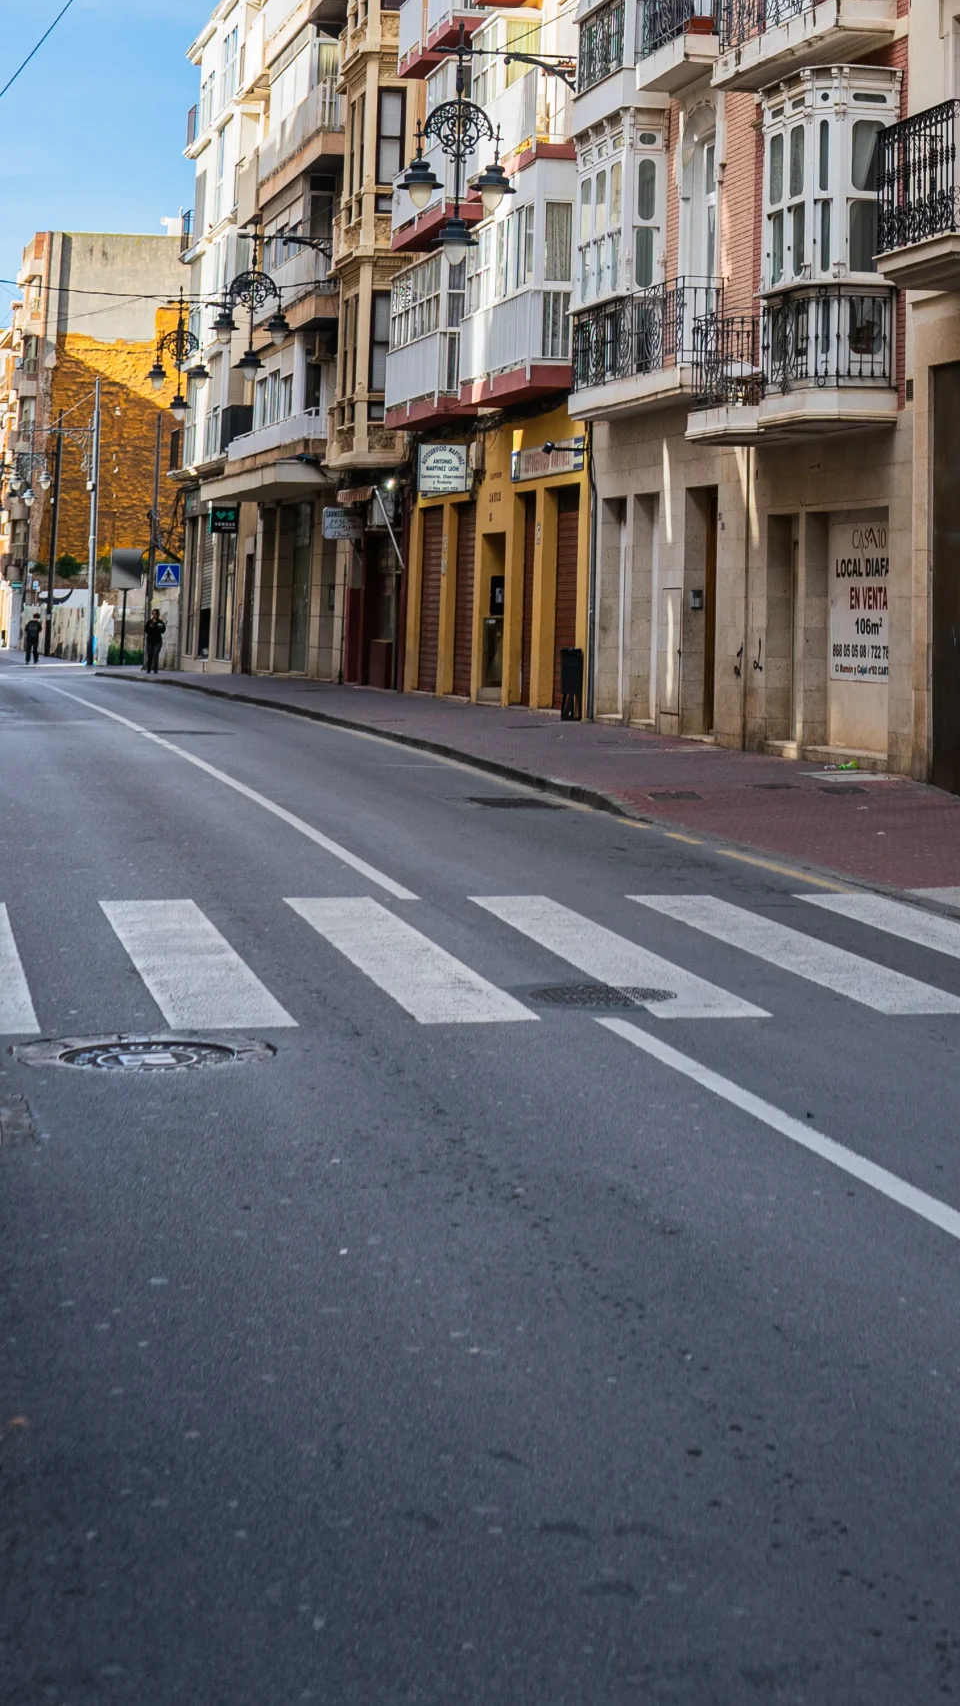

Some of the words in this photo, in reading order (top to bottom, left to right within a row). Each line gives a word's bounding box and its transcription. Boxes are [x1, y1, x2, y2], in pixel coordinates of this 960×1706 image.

[836, 558, 863, 578] LOCAL
[850, 586, 860, 610] EN
[862, 586, 888, 610] VENTA
[832, 643, 842, 658] 868
[843, 644, 850, 658] 05
[851, 644, 859, 658] 05
[871, 645, 881, 660] 722
